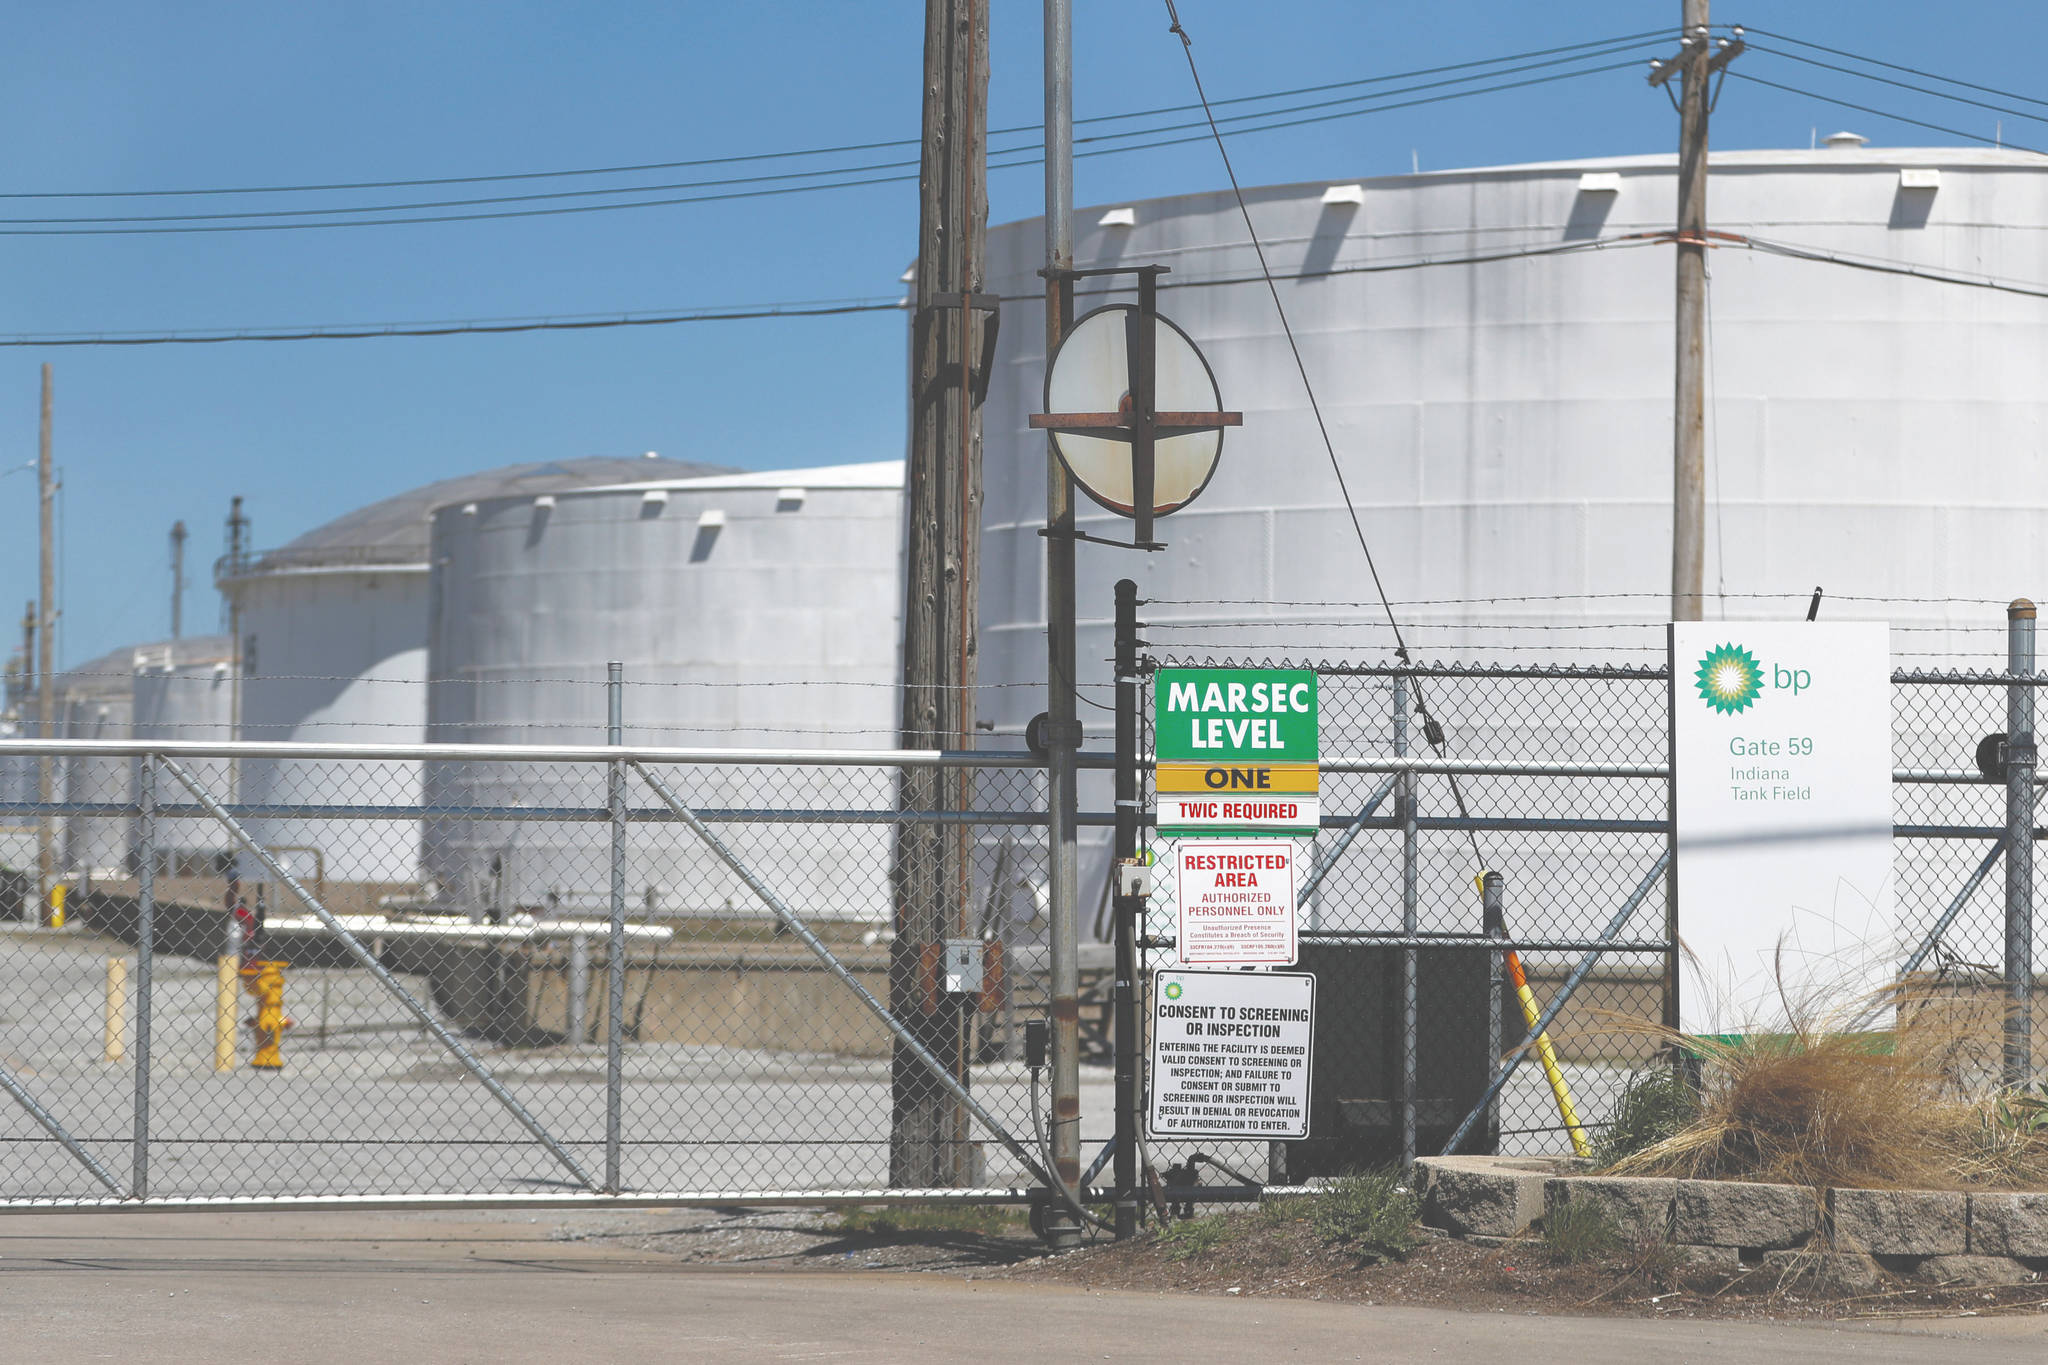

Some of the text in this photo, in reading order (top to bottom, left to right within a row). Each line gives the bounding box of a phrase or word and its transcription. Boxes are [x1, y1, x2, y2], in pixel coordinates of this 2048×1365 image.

[1774, 663, 1811, 695] bp
[1168, 682, 1308, 712] MARSEC
[1192, 719, 1284, 749] LEVEL
[1730, 737, 1813, 756] Gate 59
[1204, 768, 1270, 789] ONE
[1731, 767, 1790, 780] Indiana
[1731, 786, 1810, 800] Tank Field
[1179, 803, 1298, 820] TWIC REQUIRED
[1185, 855, 1285, 870] RESTRICTED
[1215, 873, 1258, 887] AREA
[1202, 893, 1271, 903] AUTHORIZED
[1188, 906, 1285, 916] PERSONNEL ONLY
[1159, 1005, 1308, 1022] CONSENT TO SCREENING
[1186, 1023, 1280, 1038] OR INSPECTION
[1160, 1043, 1305, 1055] ENTERING THE FACILITY IS DEEMED
[1162, 1055, 1301, 1068] VALID CONSENT TO SCREENING OR
[1171, 1068, 1291, 1080] INSPECTION; AND FAILURE TO
[1181, 1081, 1280, 1092] CONSENT OR SUBMIT TO
[1163, 1094, 1296, 1105] SCREENING OR INSPECTION WILL
[1160, 1106, 1300, 1118] RESULT IN DENIAL OR REVOCATION
[1168, 1119, 1290, 1130] OF AUTHORIZATION TO ENTER.
